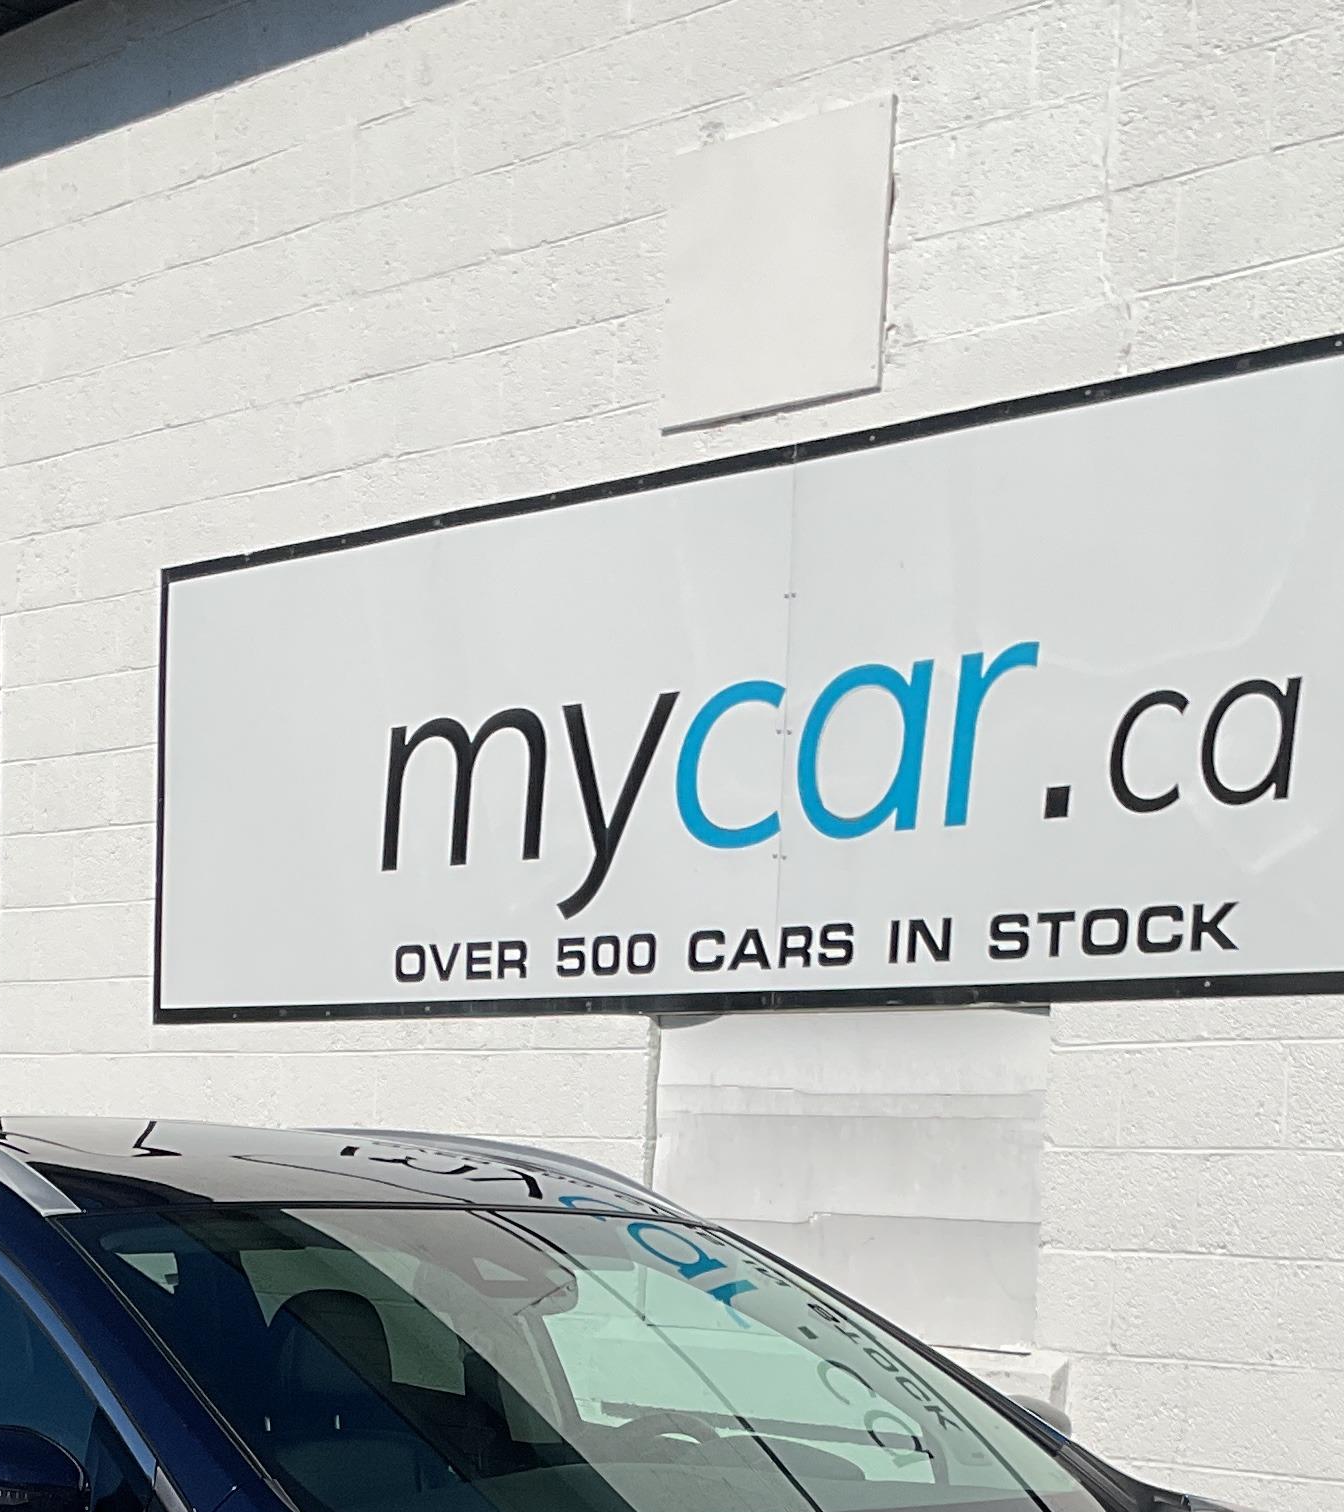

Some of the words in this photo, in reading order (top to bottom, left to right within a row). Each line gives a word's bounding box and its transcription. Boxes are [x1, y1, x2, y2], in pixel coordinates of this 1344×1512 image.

[381, 641, 1302, 919] mycar.ca
[394, 940, 529, 983] OVER
[556, 933, 657, 978] 500
[687, 922, 854, 972] CARS
[888, 917, 953, 964] IN
[988, 901, 1240, 960] STOCK
